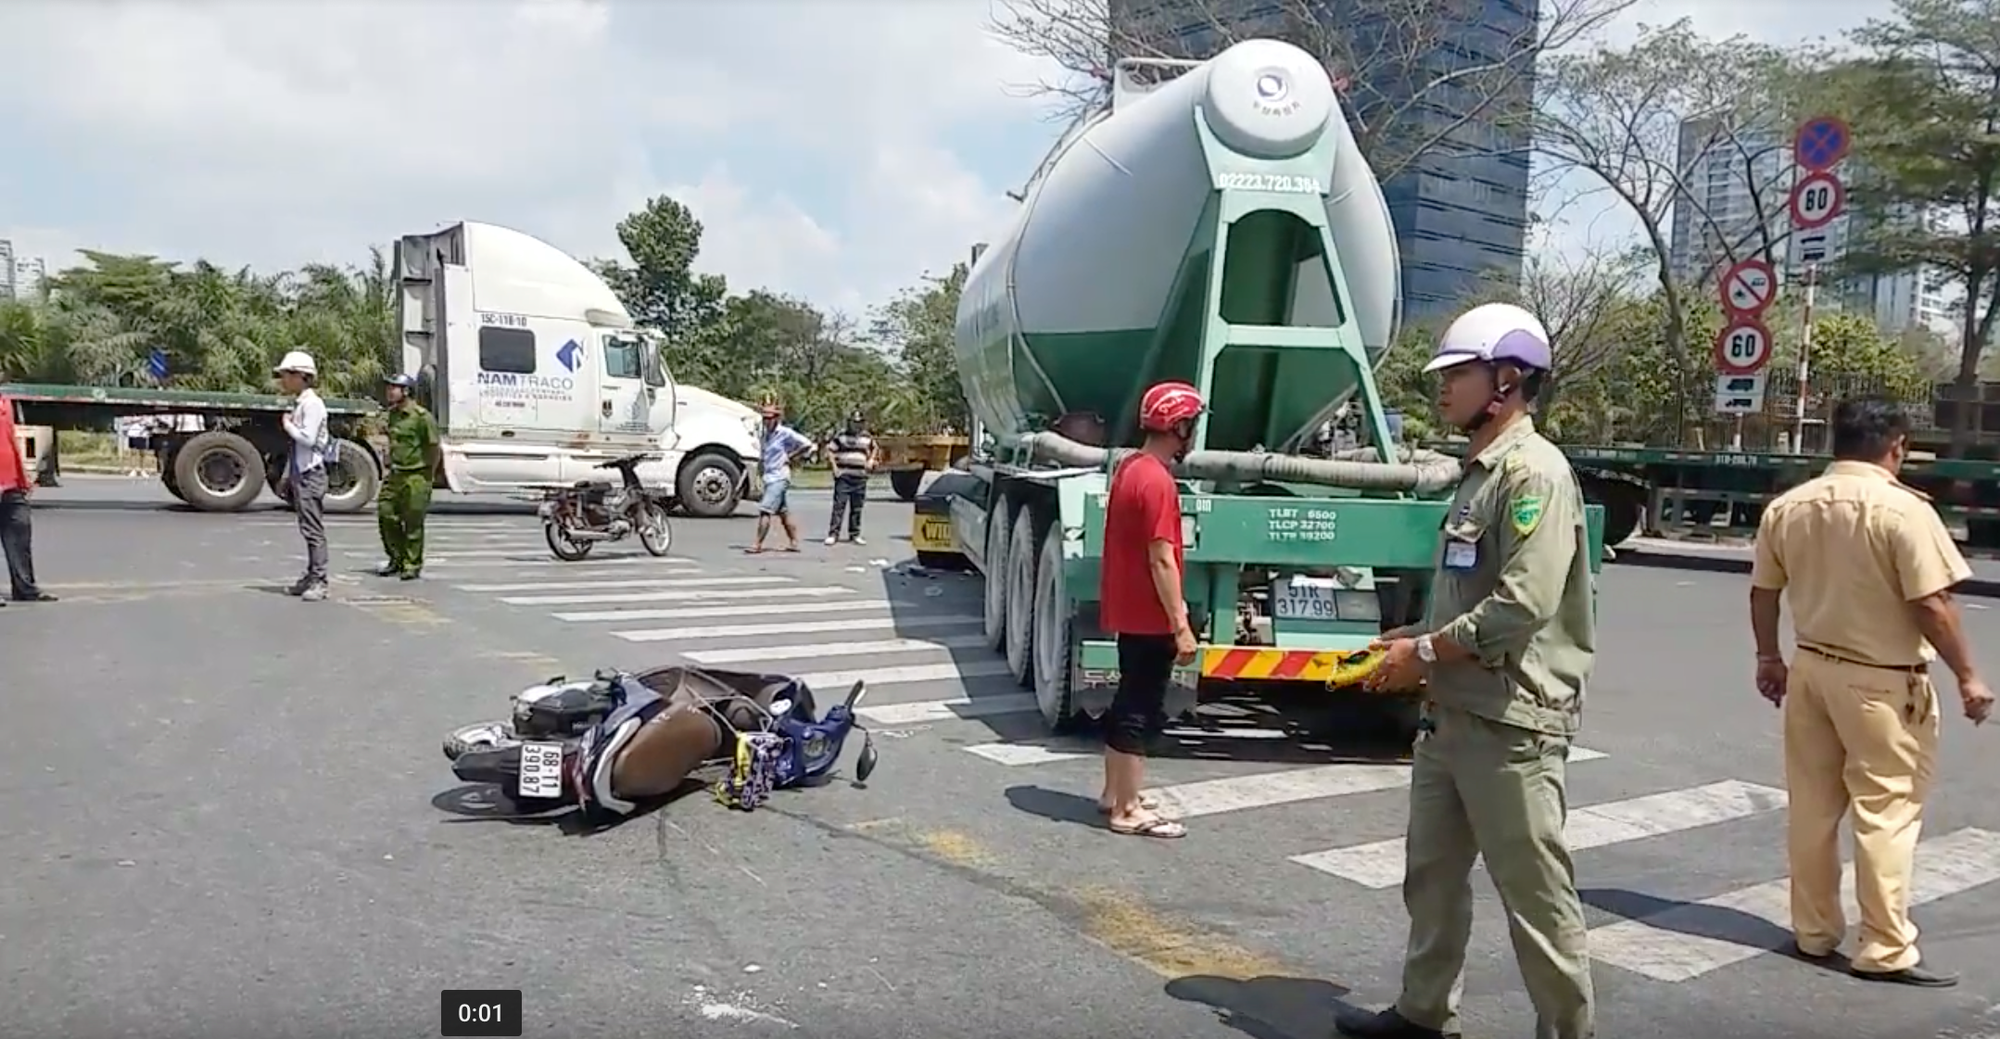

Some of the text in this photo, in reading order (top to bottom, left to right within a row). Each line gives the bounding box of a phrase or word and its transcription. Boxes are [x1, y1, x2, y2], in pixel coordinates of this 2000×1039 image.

[1805, 187, 1828, 212] 80
[1731, 334, 1756, 358] 60
[1287, 582, 1320, 599] 51R
